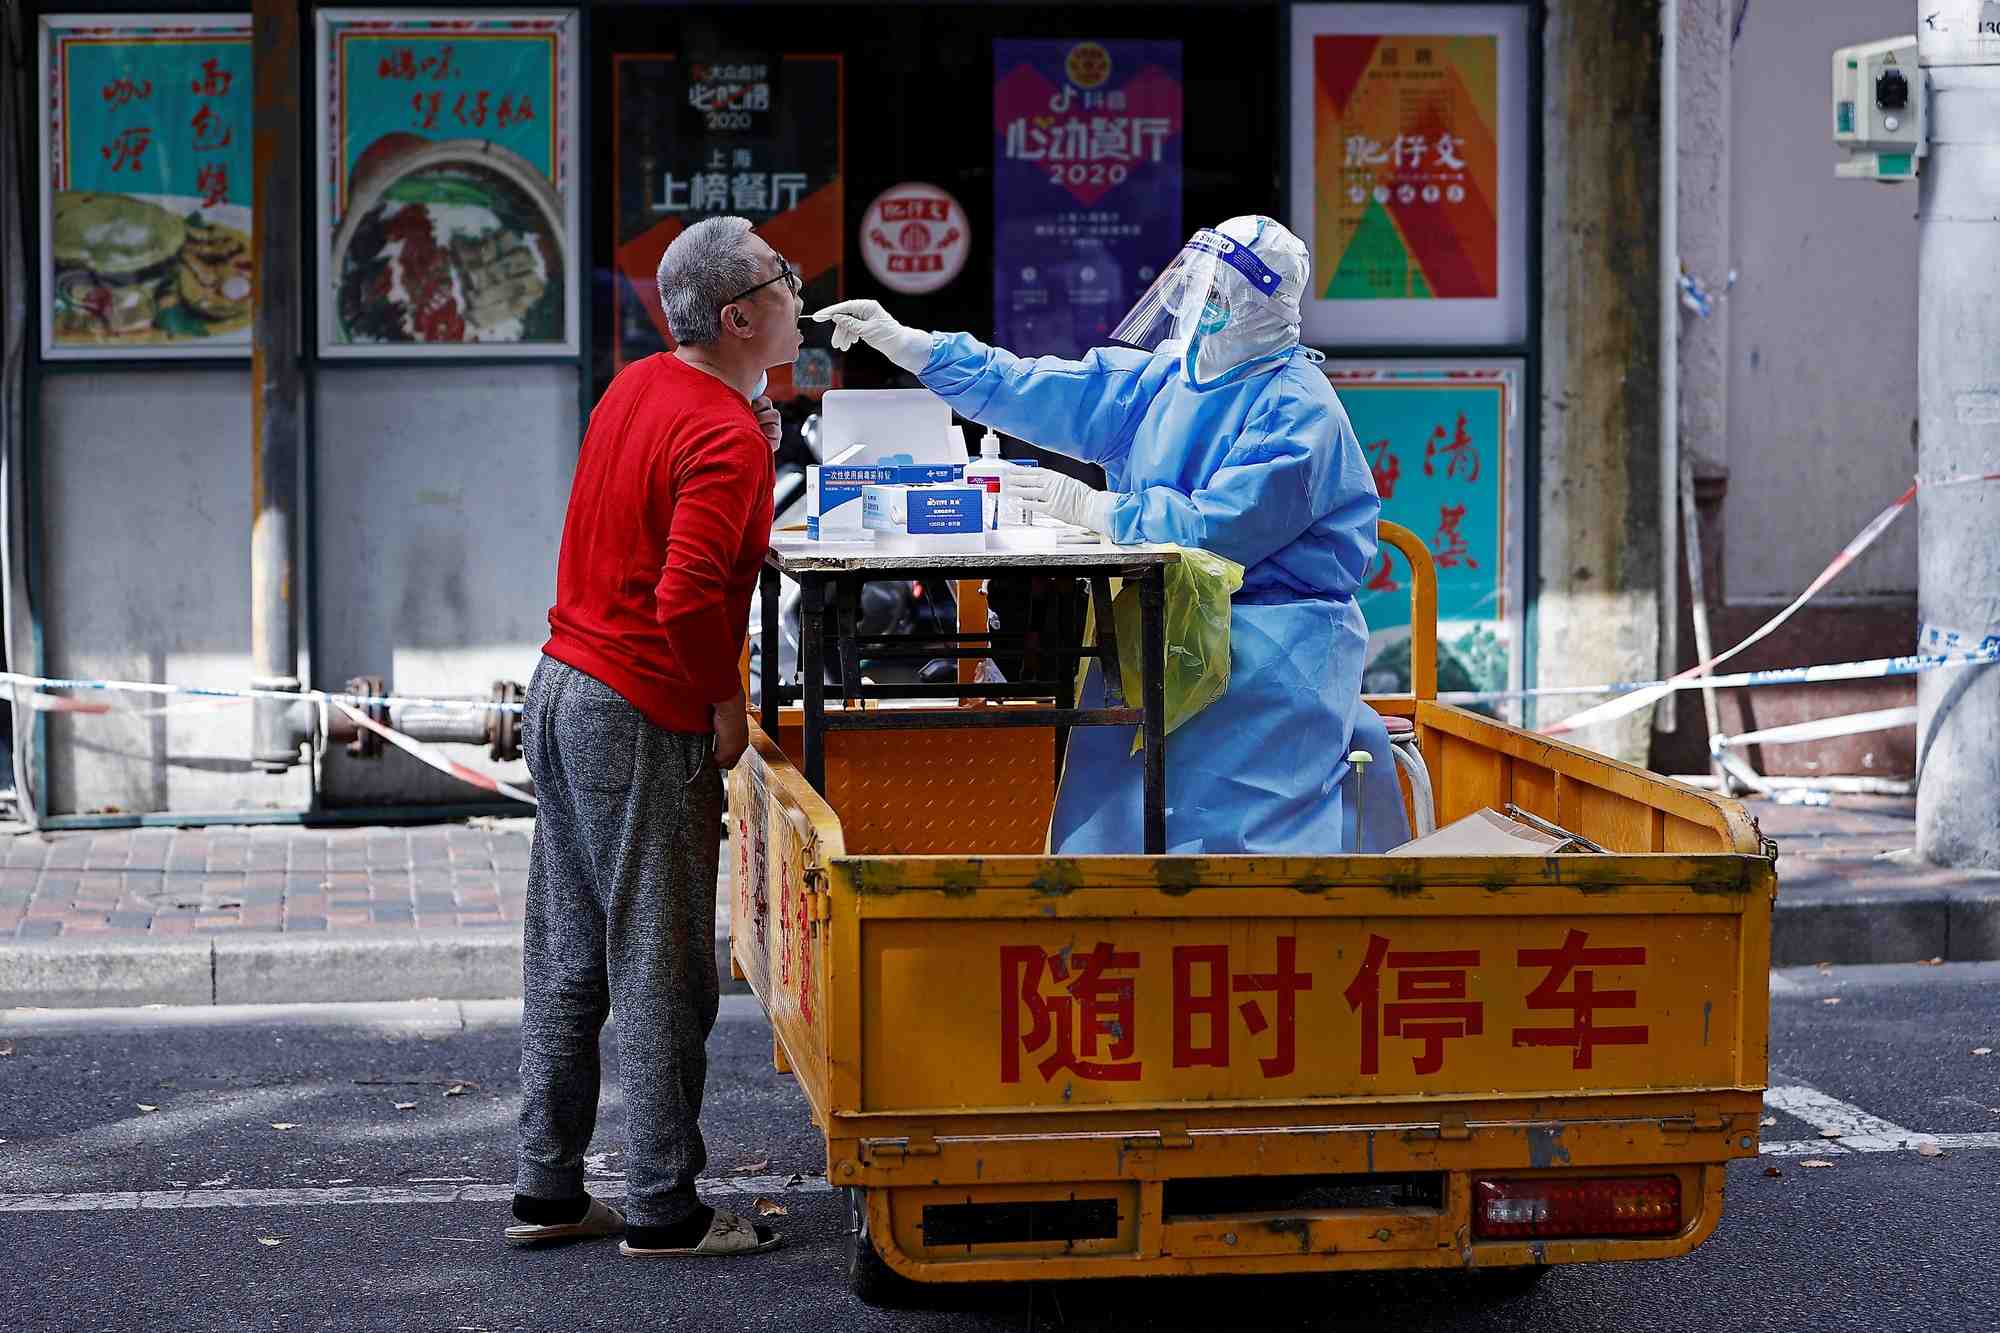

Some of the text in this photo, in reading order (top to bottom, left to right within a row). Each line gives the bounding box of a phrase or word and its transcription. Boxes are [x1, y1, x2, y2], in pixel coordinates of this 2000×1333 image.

[706, 112, 752, 129] 2020
[1006, 117, 1171, 162] 心动餐厅
[651, 172, 808, 211] 上榜餐厅
[1050, 164, 1128, 184] 2020
[1000, 929, 1649, 1084] 随时停车
